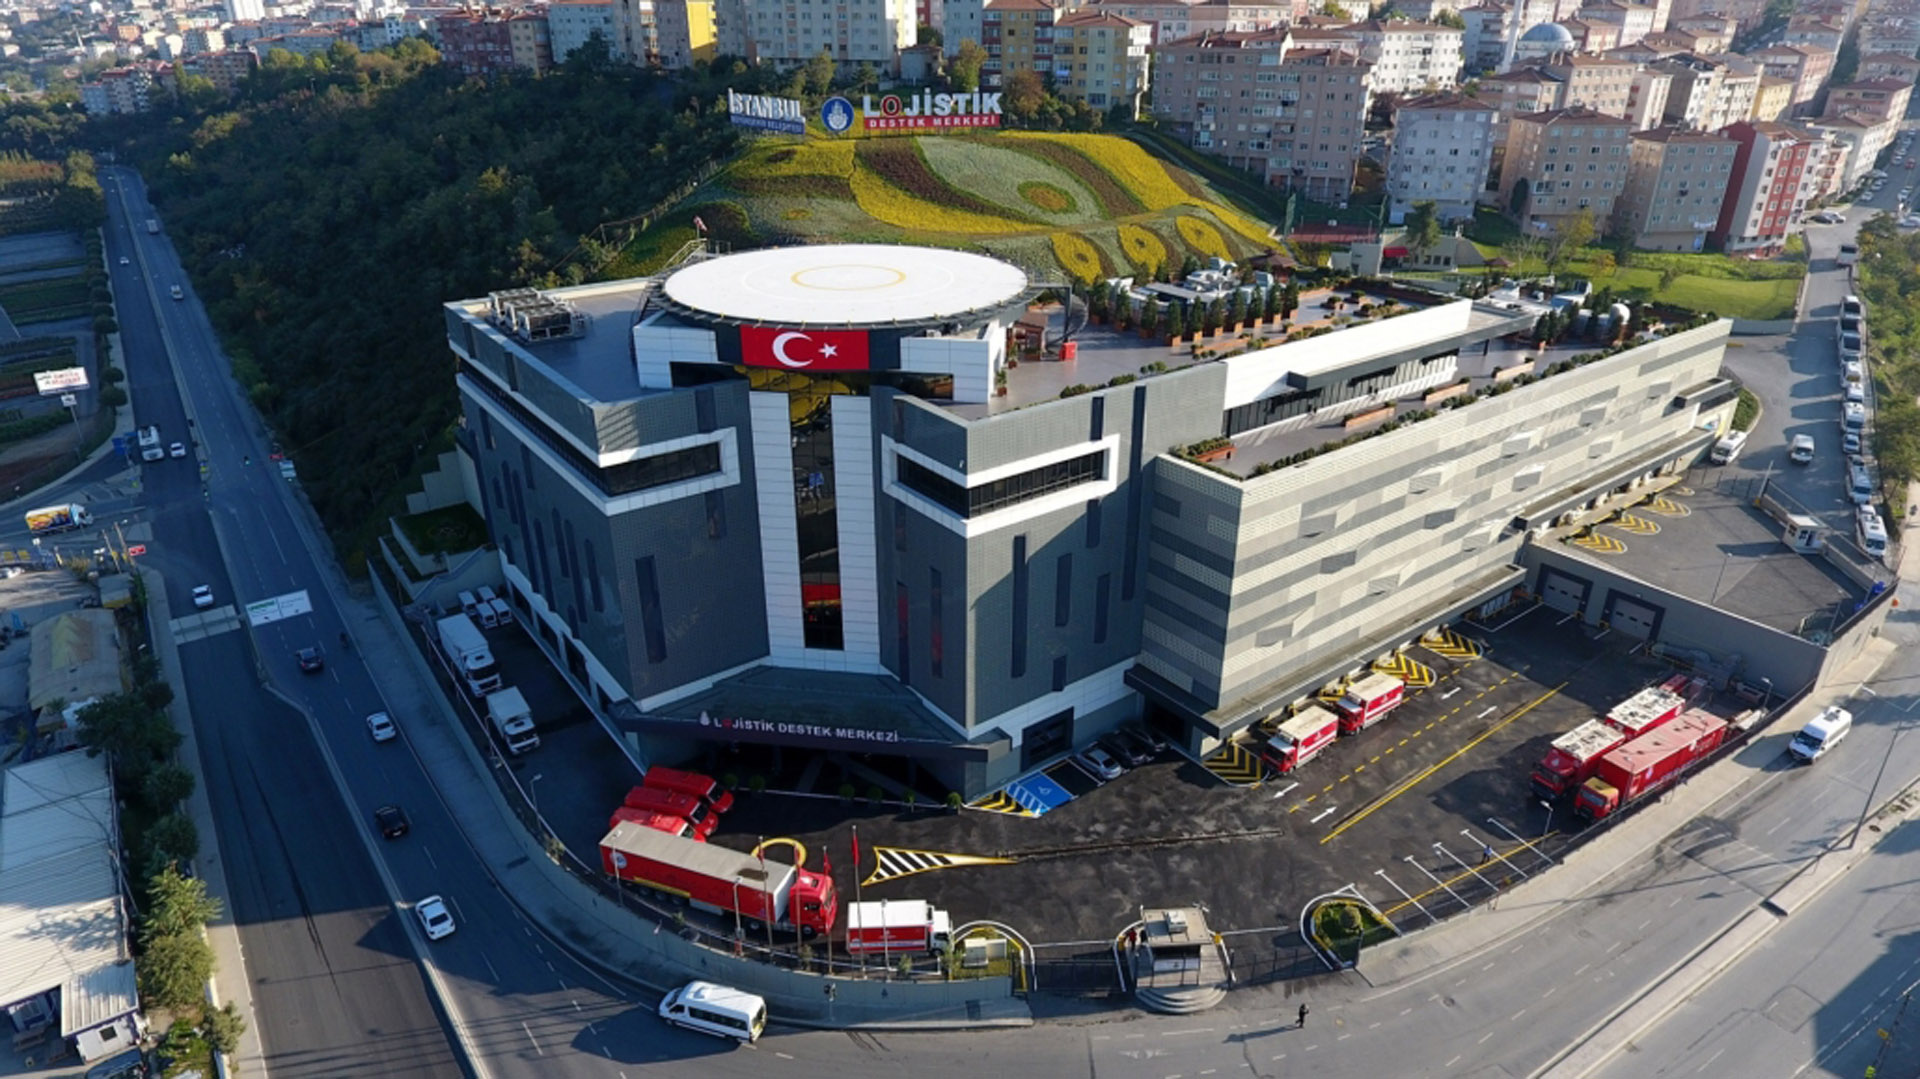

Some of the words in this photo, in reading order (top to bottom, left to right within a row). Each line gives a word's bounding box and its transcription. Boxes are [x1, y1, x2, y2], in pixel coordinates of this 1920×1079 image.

[728, 87, 806, 123] İSTANBUL
[863, 87, 1003, 117] LOJİSTİK
[869, 118, 926, 128] DESTEK
[933, 115, 996, 126] MERKEZİ
[713, 717, 775, 732] LOJİSTİK
[778, 722, 832, 737] DESTEK
[836, 728, 899, 743] MERKEZİ
